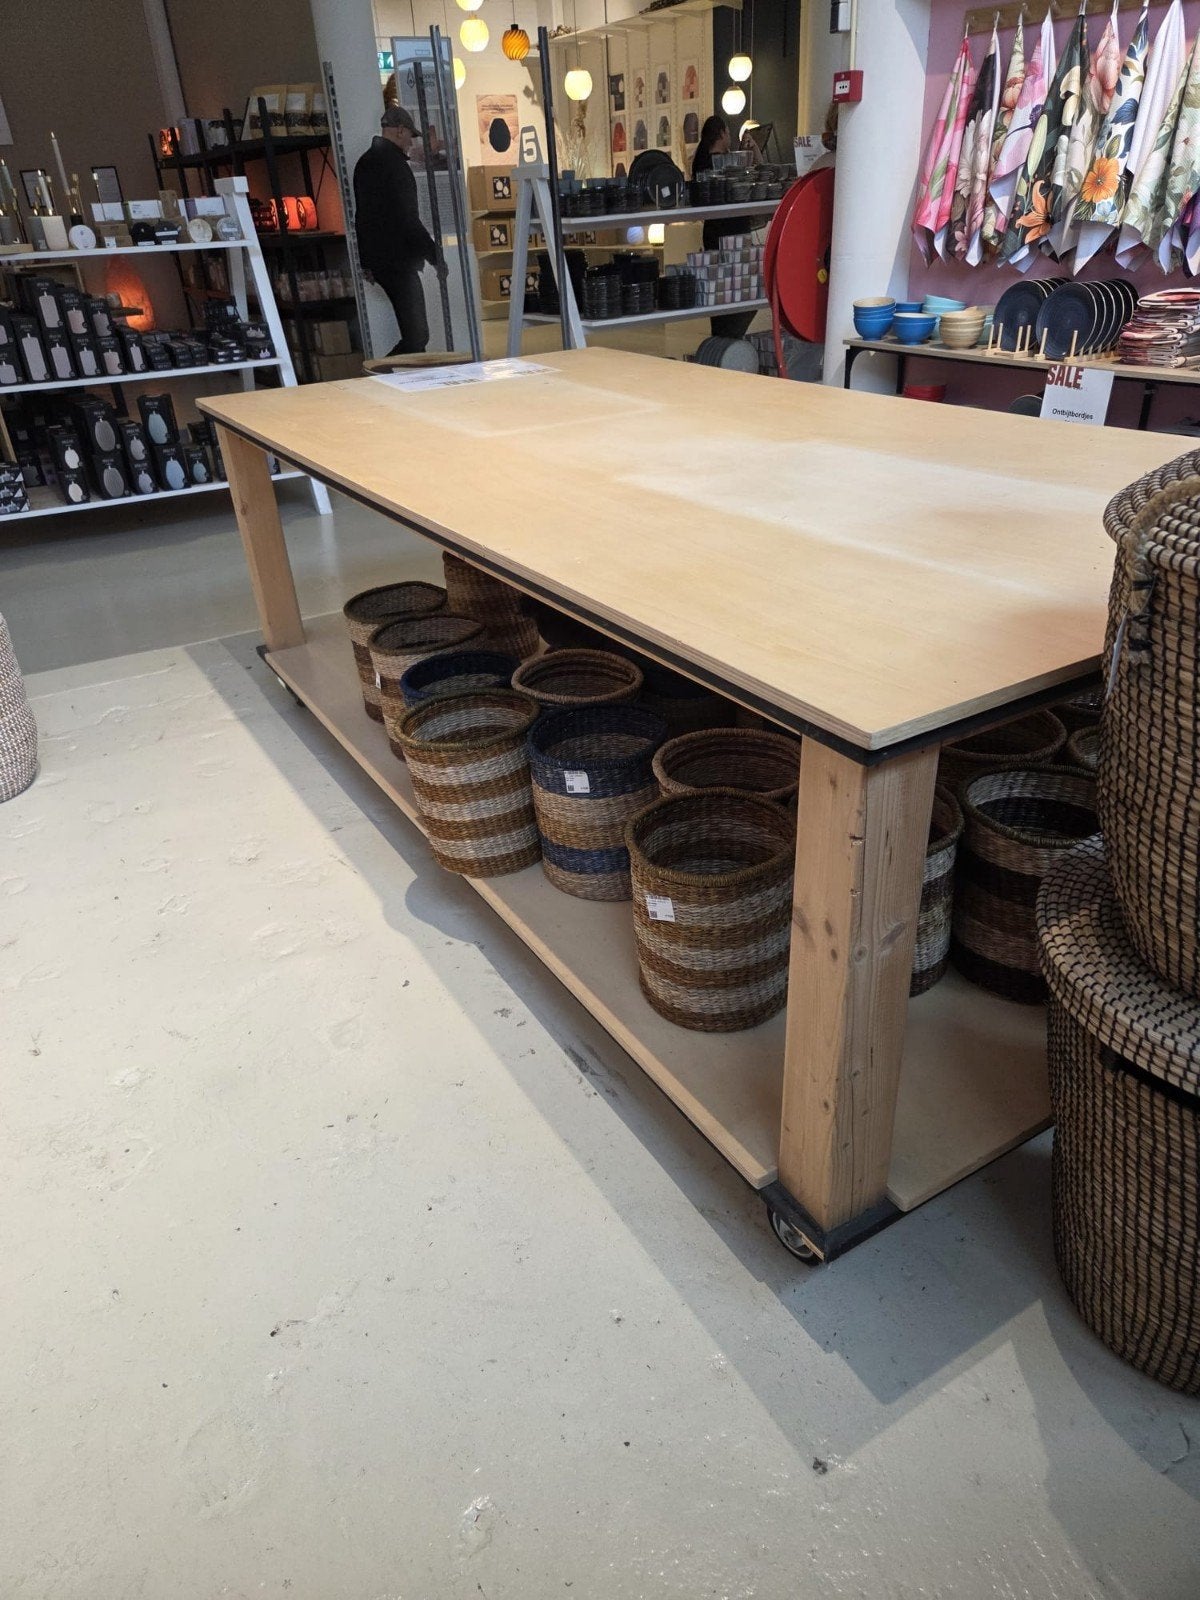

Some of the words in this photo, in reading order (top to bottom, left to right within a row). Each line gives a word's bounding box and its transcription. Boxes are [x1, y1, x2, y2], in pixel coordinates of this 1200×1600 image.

[522, 131, 537, 163] 5
[793, 136, 812, 148] SALE
[1046, 364, 1085, 389] SALE
[1052, 408, 1094, 420] Ontbijtbordjes
